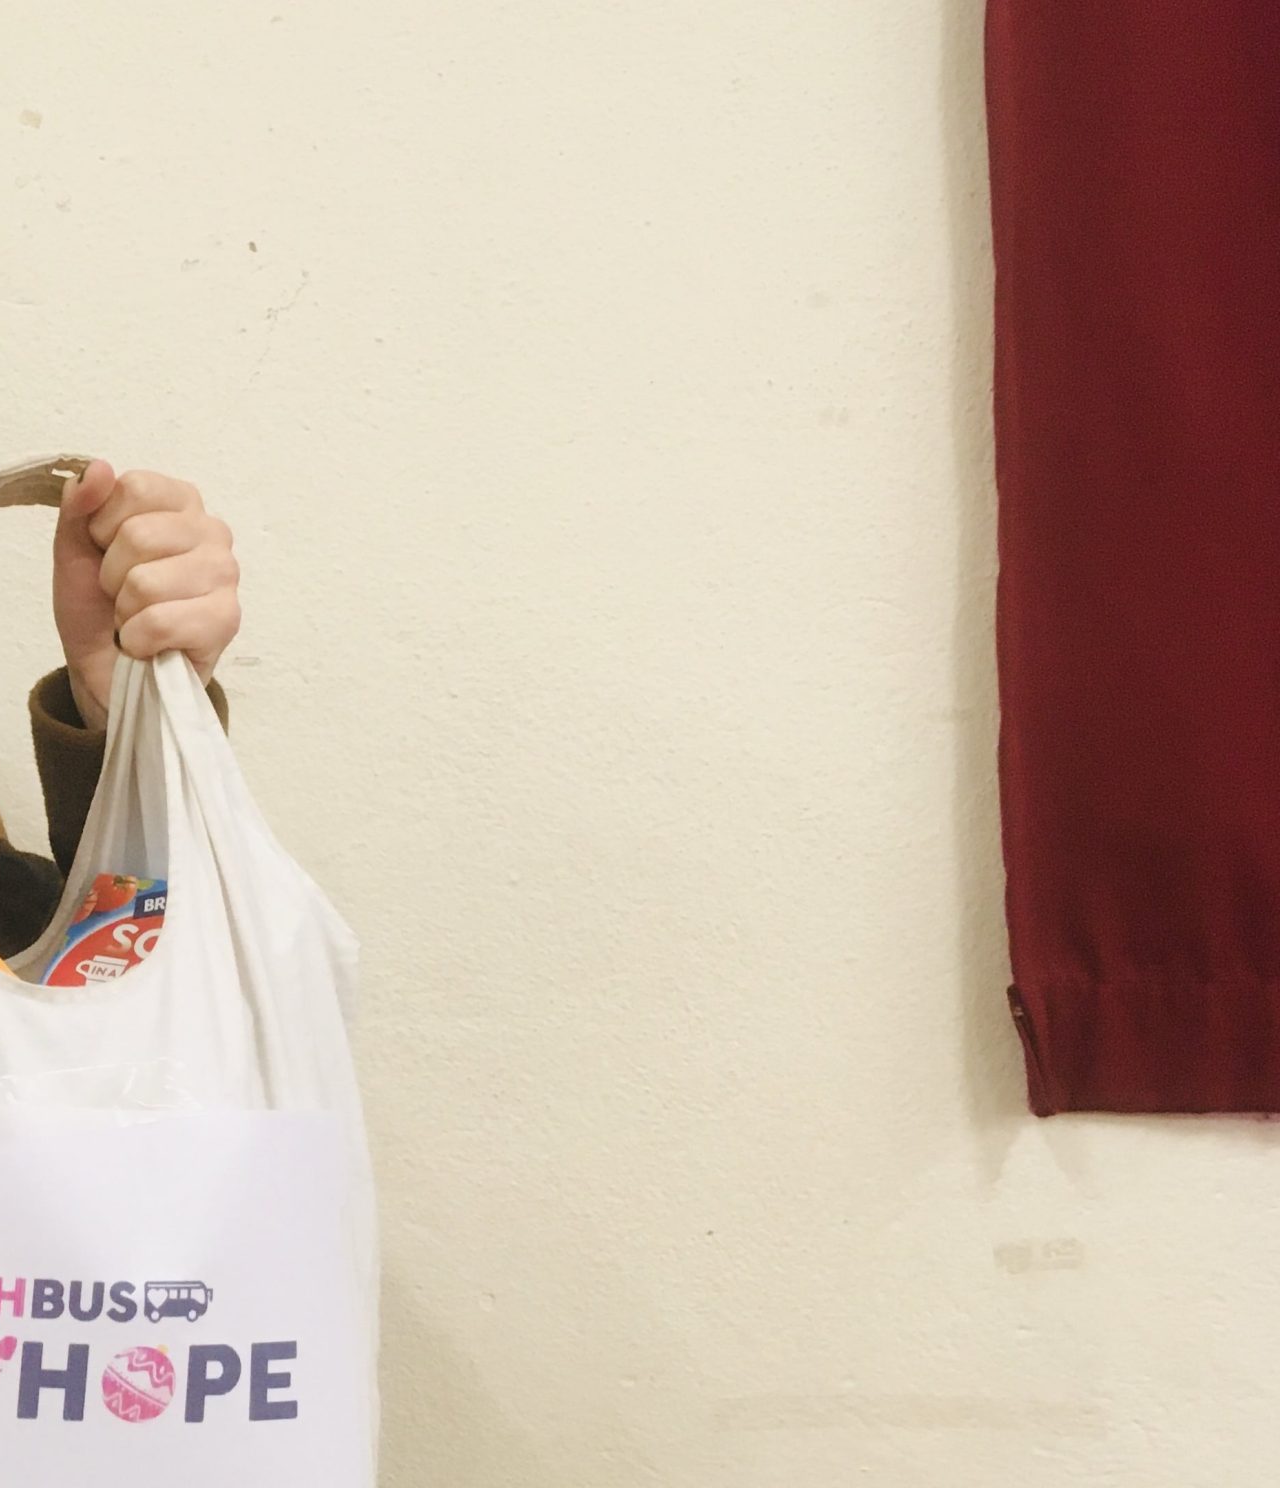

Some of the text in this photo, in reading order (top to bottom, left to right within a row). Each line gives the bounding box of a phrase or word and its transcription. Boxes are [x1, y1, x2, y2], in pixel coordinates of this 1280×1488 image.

[91, 965, 117, 978] IN A
[17, 1340, 298, 1423] HOPE
